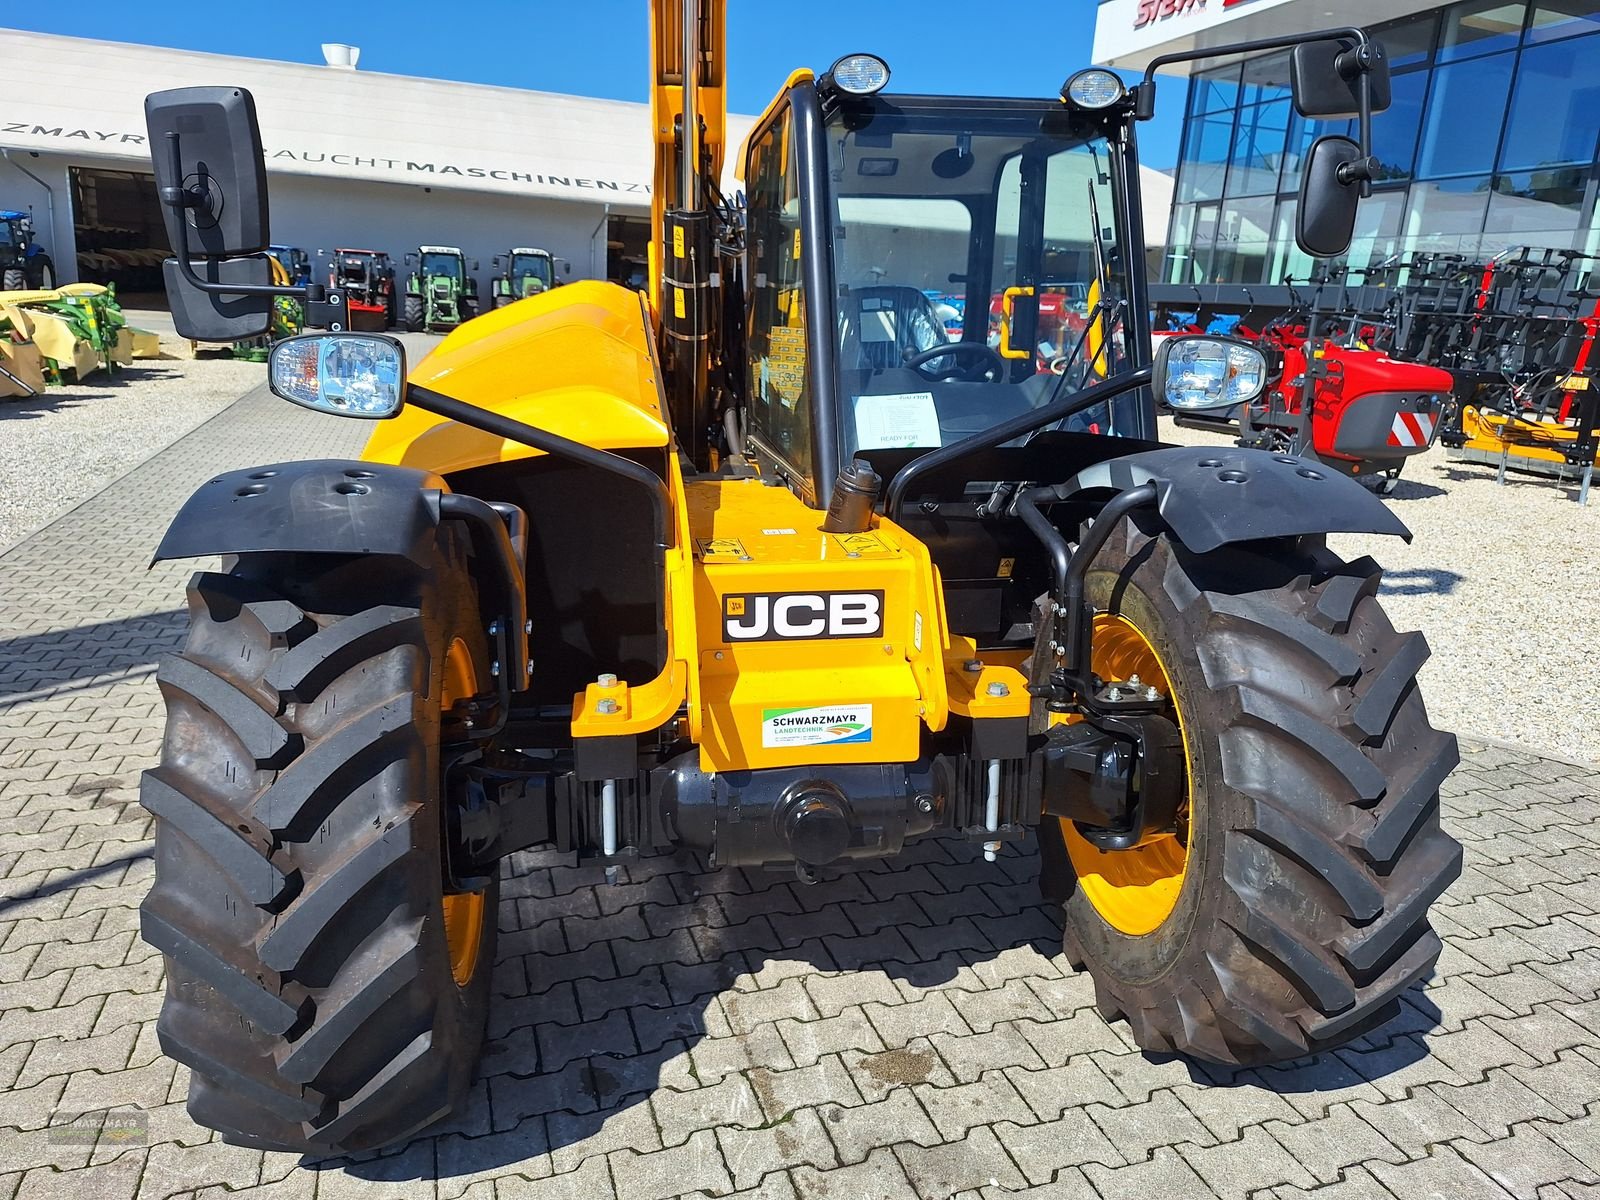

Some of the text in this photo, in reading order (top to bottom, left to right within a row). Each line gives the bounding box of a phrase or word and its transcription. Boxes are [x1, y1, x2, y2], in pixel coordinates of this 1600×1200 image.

[726, 594, 881, 639] JCB
[773, 714, 857, 727] SCHWARZMAYR
[774, 726, 823, 735] LANDTECHNIK
